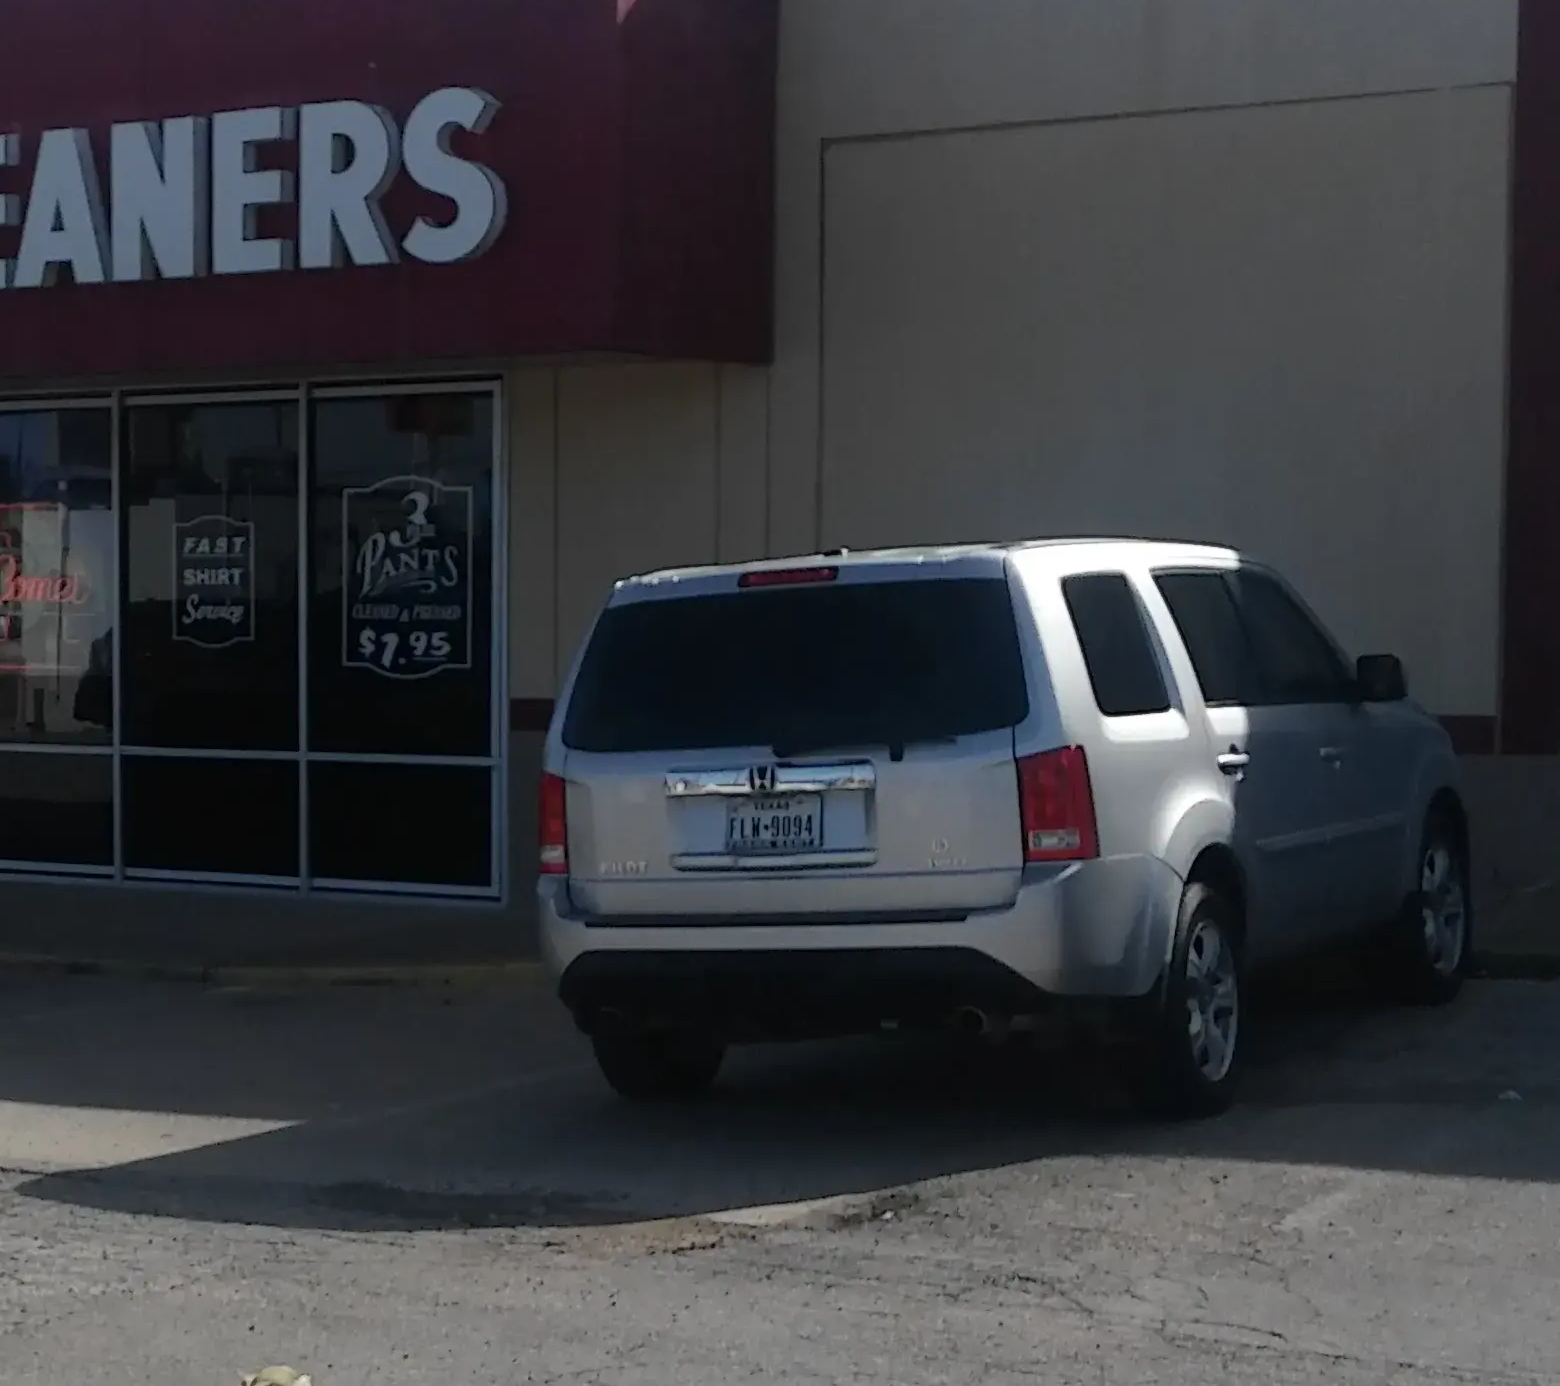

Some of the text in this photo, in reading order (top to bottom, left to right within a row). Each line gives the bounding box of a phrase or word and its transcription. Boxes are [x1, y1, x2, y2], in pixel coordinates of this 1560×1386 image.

[182, 536, 247, 556] FAST
[356, 531, 459, 599] PANTS
[181, 566, 243, 586] SHIRT
